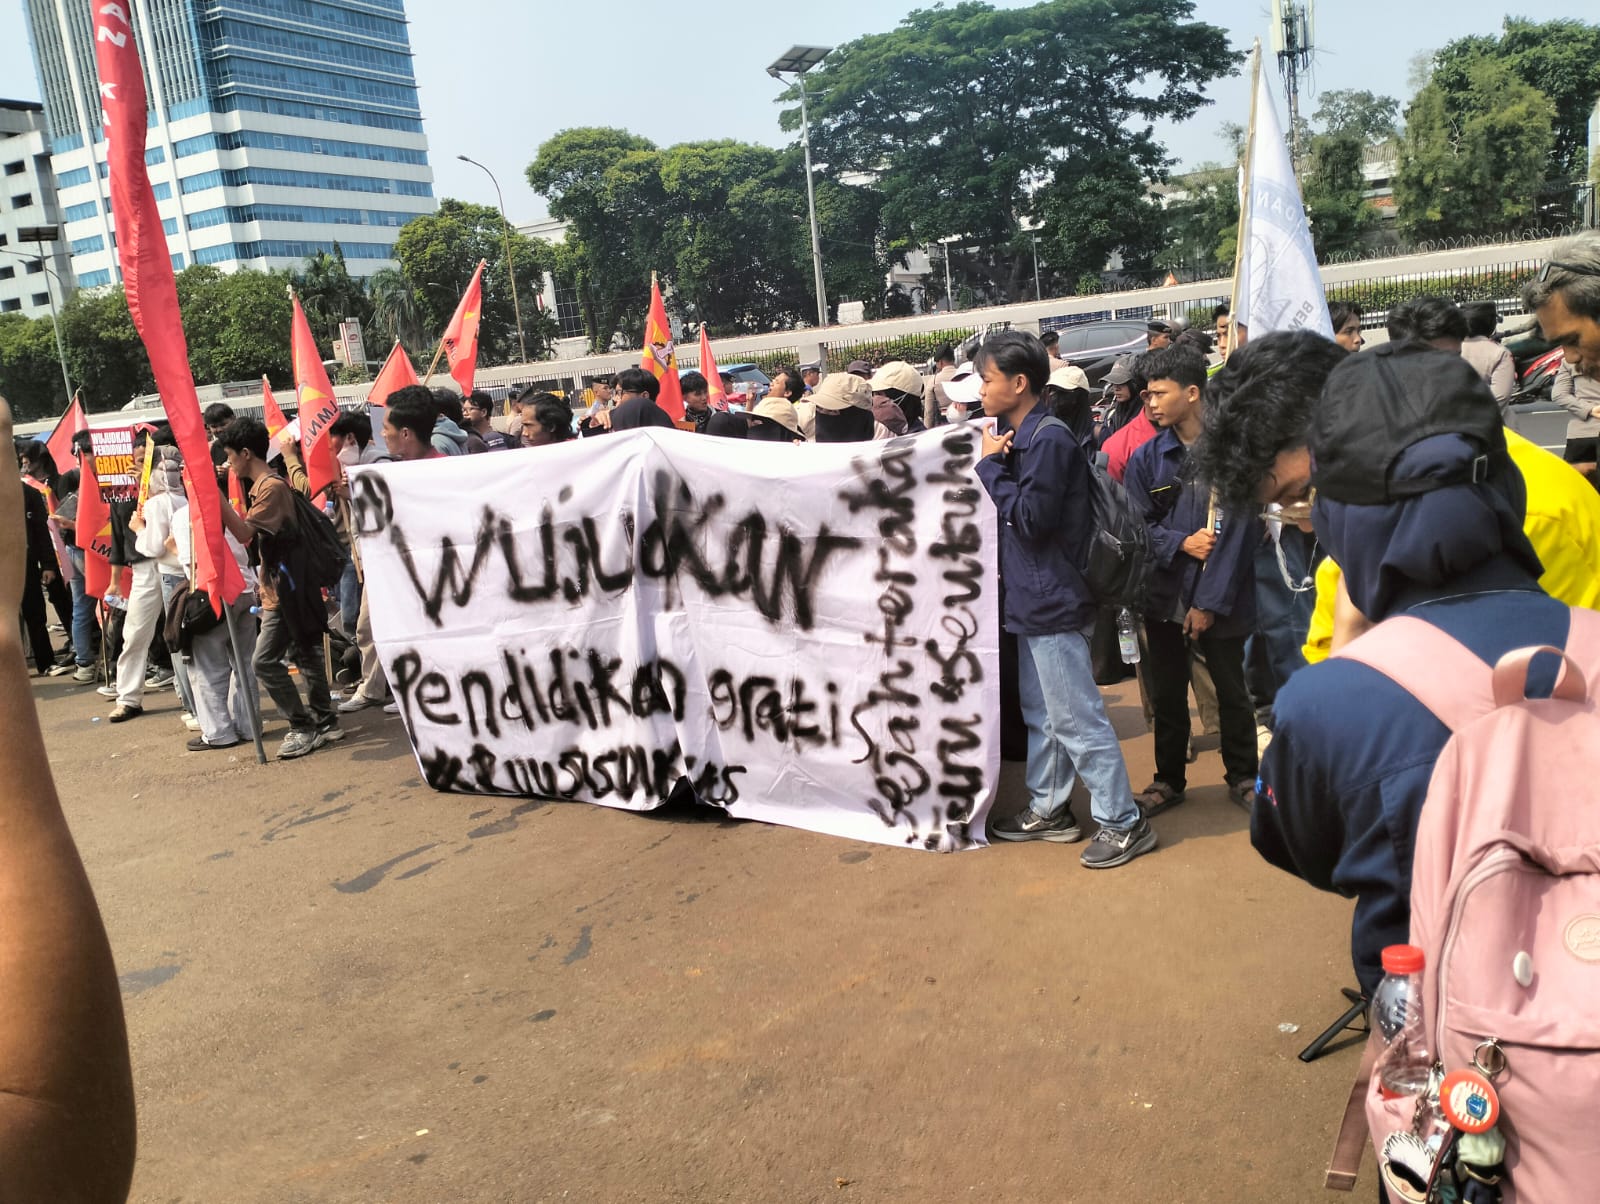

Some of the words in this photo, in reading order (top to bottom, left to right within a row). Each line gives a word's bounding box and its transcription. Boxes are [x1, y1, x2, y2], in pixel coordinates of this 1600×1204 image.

[90, 431, 132, 445] WUJUDKAN
[93, 443, 133, 457] PENDIDIKAN
[95, 455, 134, 475] GRATIS
